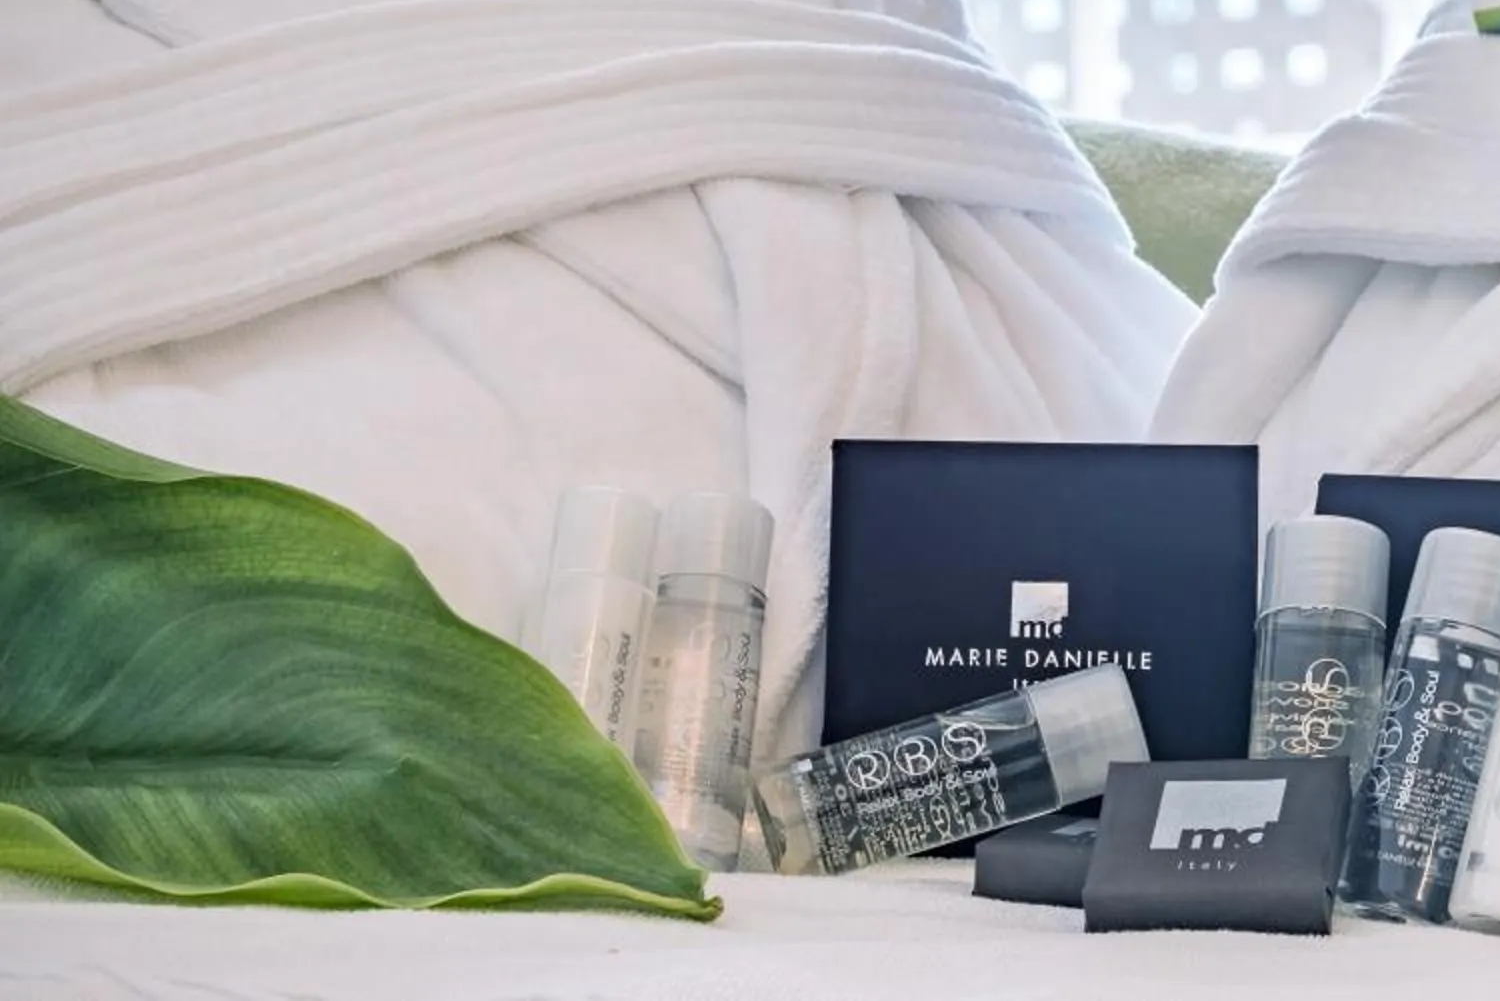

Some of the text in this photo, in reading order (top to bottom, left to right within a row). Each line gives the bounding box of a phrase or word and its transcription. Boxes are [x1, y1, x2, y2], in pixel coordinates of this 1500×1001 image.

[924, 647, 1008, 667] MARIE
[1394, 670, 1441, 810] Relax Body & Soul
[903, 779, 944, 802] Body
